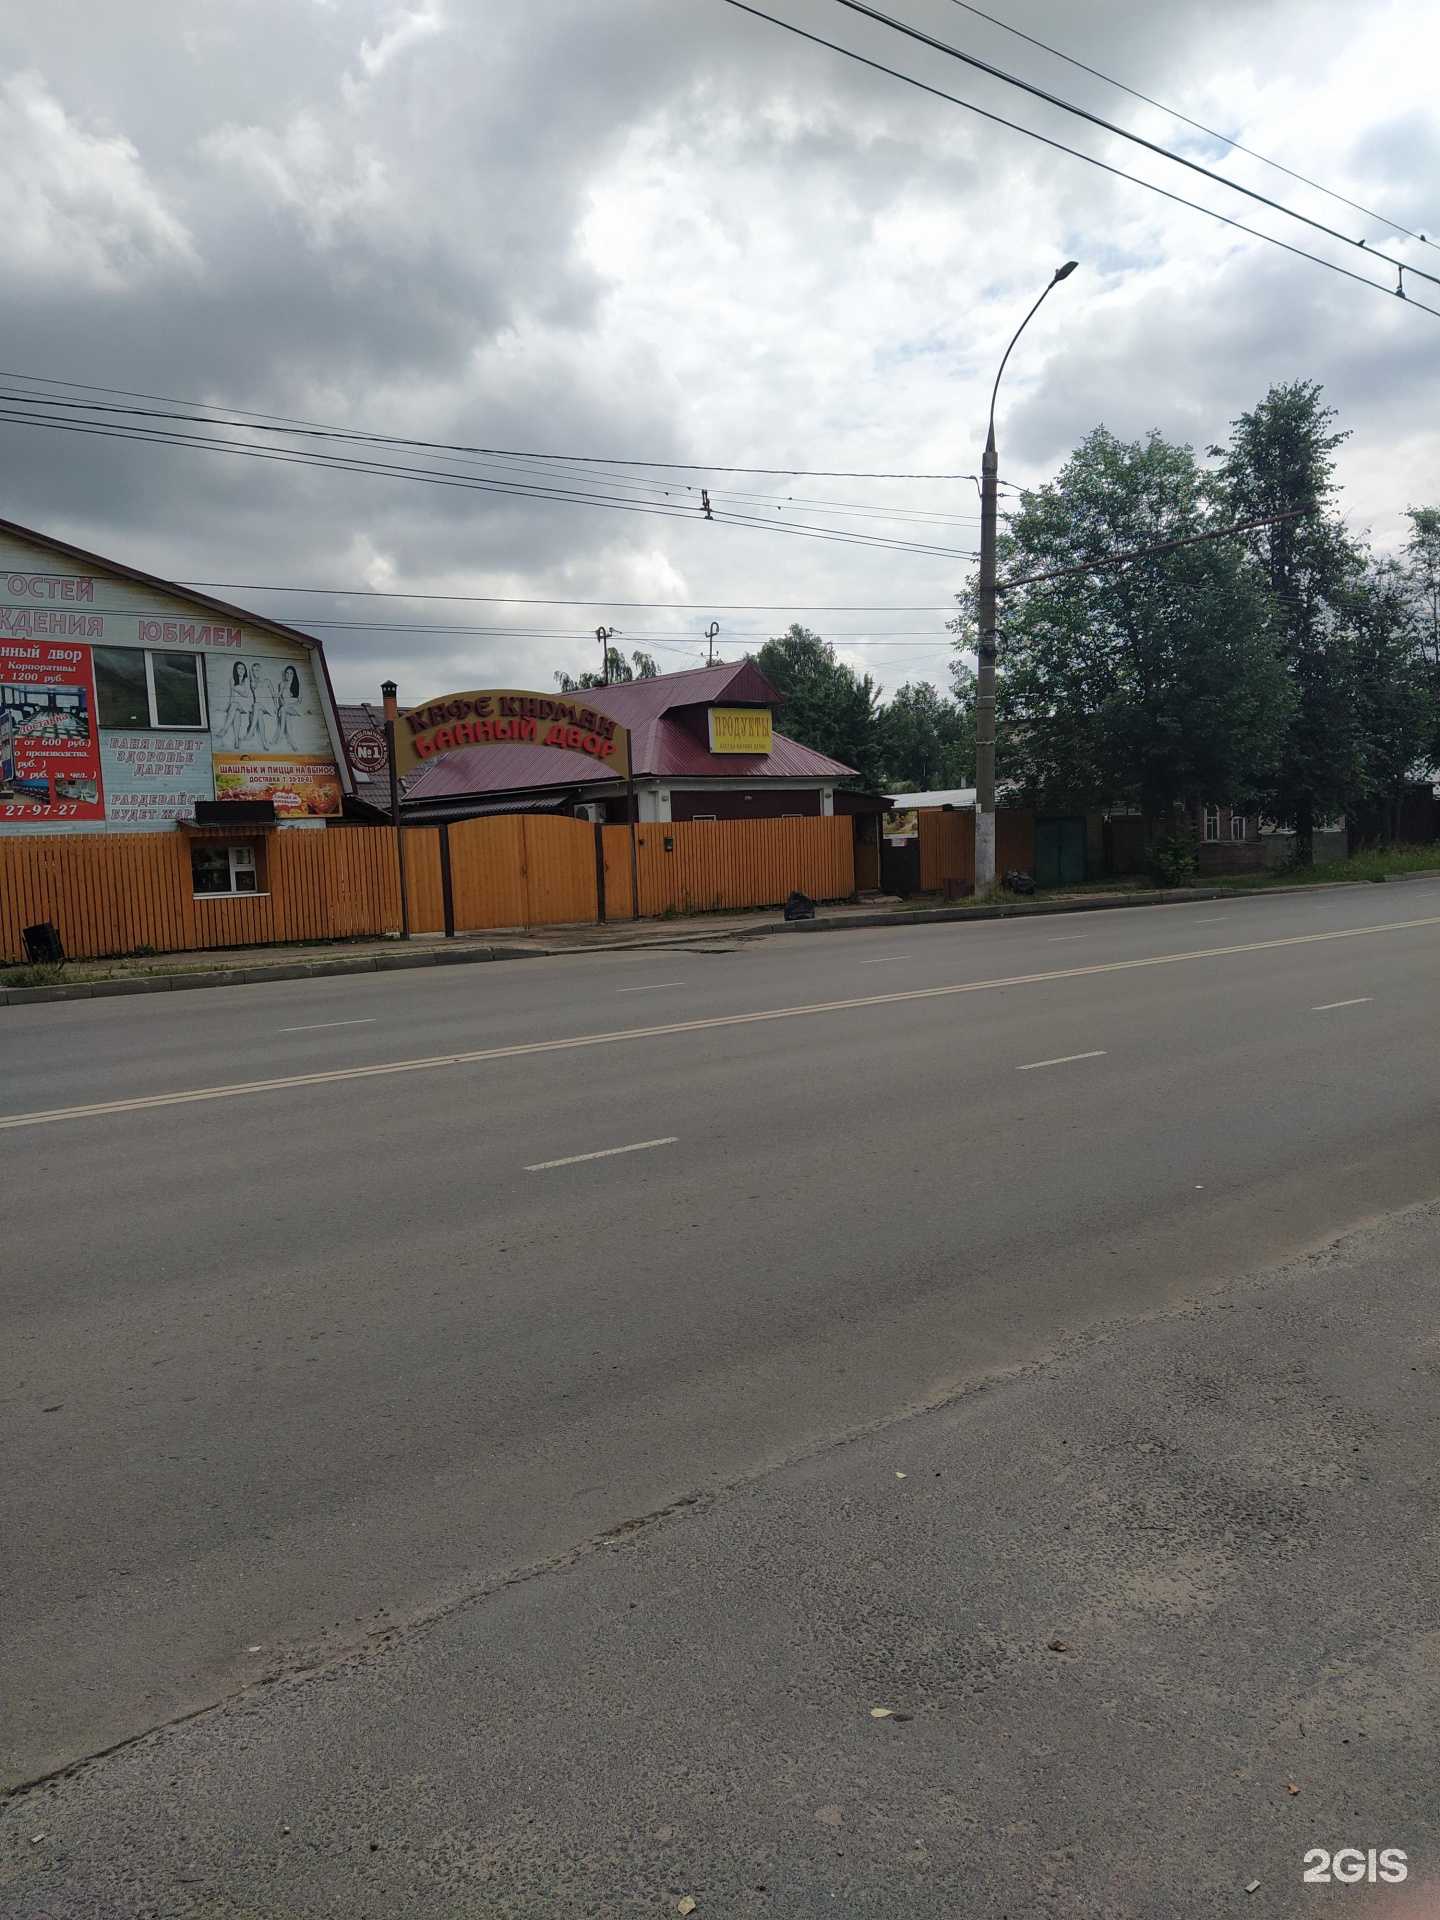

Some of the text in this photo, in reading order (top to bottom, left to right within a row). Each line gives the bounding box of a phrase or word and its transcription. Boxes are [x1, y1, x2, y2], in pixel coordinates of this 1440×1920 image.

[0, 574, 95, 603] ОСТЕЙ
[138, 620, 242, 649] ЮБИЛЕЙ
[0, 645, 40, 659] нный
[12, 672, 38, 681] 1200
[714, 716, 769, 739] ПРОДУКТЫ
[544, 723, 618, 759] ДВОР
[5, 804, 78, 816] 27-97-27
